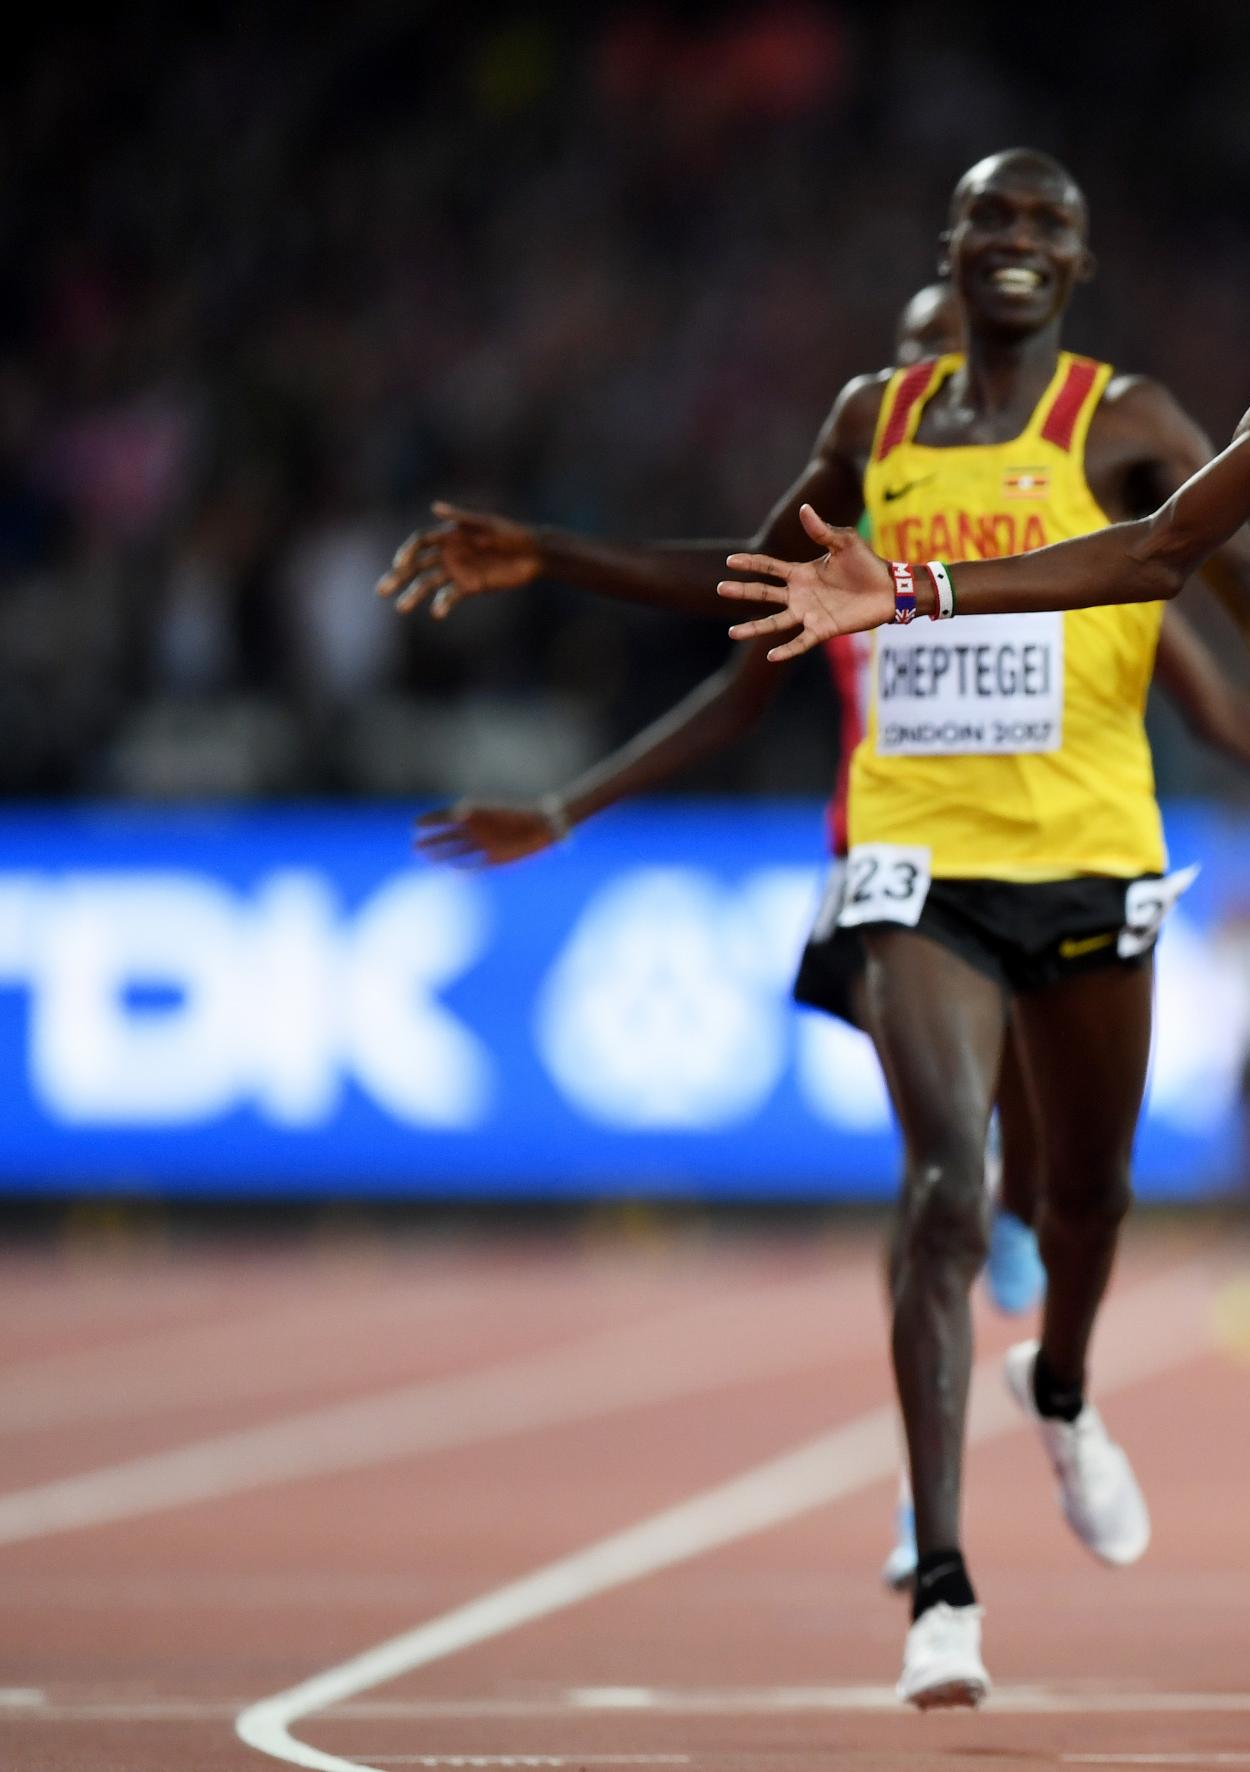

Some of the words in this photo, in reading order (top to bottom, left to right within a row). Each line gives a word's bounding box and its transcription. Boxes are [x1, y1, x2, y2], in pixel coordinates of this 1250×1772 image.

[879, 510, 1049, 564] UGANDA
[879, 643, 1051, 698] CHEPTEGEI
[879, 722, 985, 746] LONDON
[993, 720, 1053, 744] 2017
[851, 857, 918, 903] 23
[0, 865, 490, 1128] DK
